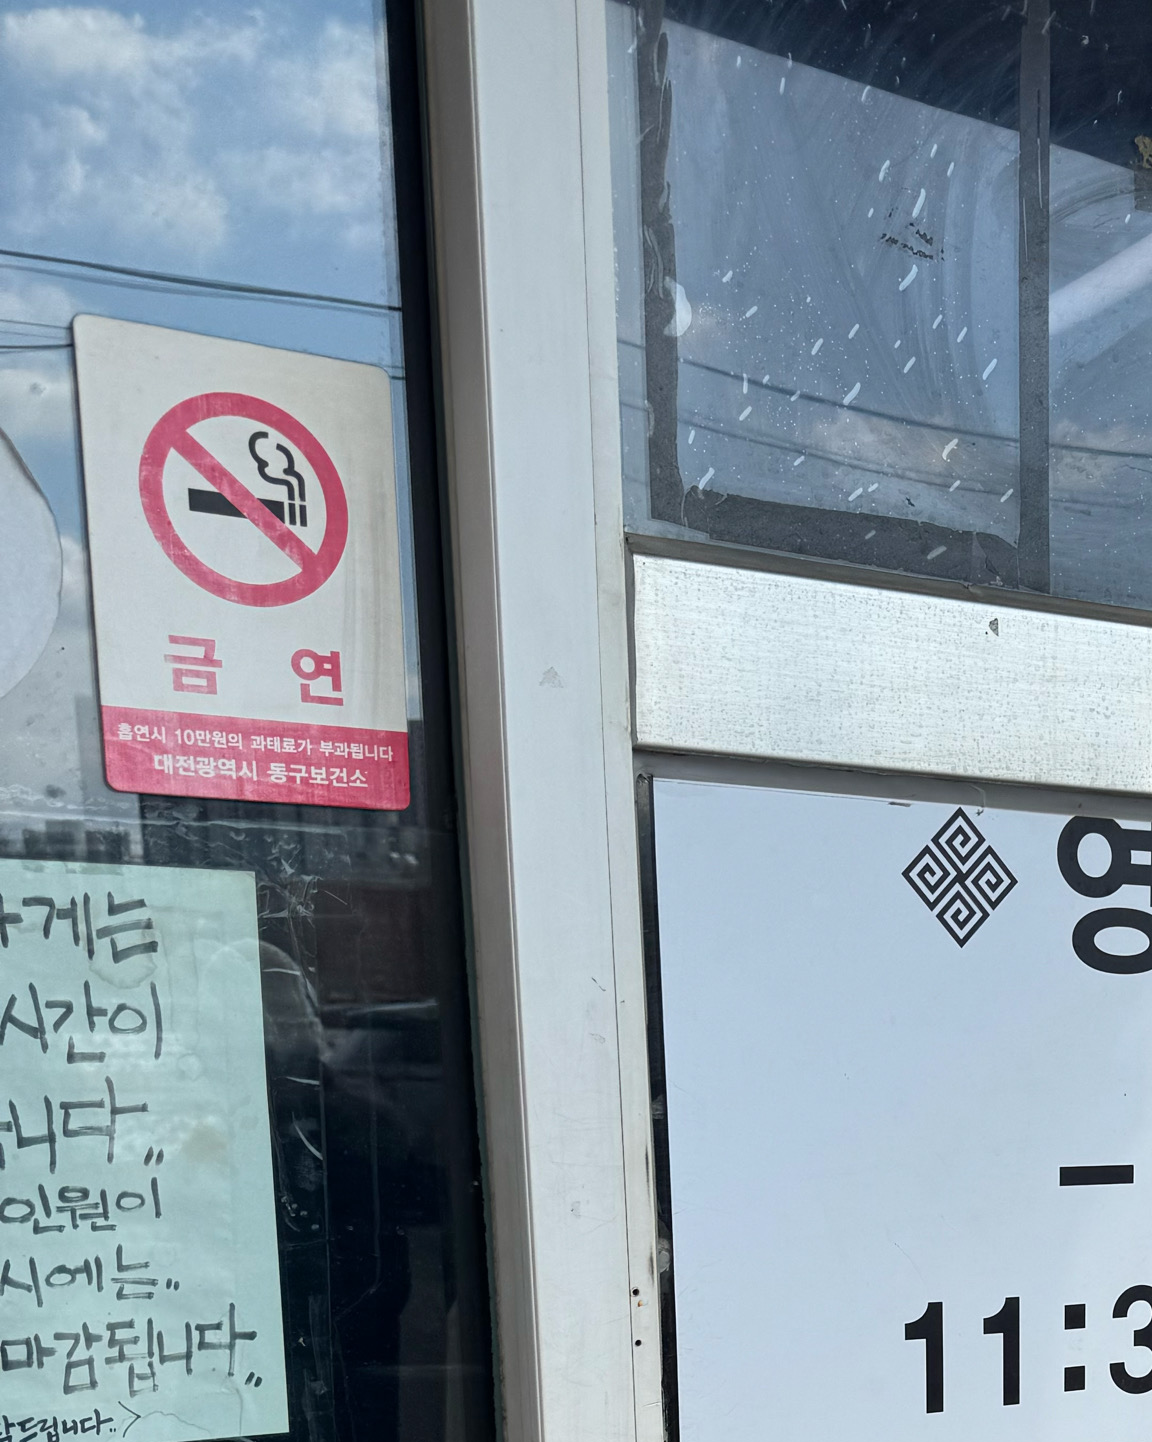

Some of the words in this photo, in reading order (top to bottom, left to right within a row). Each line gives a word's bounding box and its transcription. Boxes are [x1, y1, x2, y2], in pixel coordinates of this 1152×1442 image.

[164, 635, 223, 695] 금
[290, 648, 344, 706] 연
[117, 722, 166, 743] 흡연시
[175, 728, 242, 750] 10만원의
[251, 735, 312, 756] 과태료가
[319, 741, 393, 762] 부과됩니다
[154, 754, 257, 781] 대전광역시
[267, 762, 368, 788] 동구보건소
